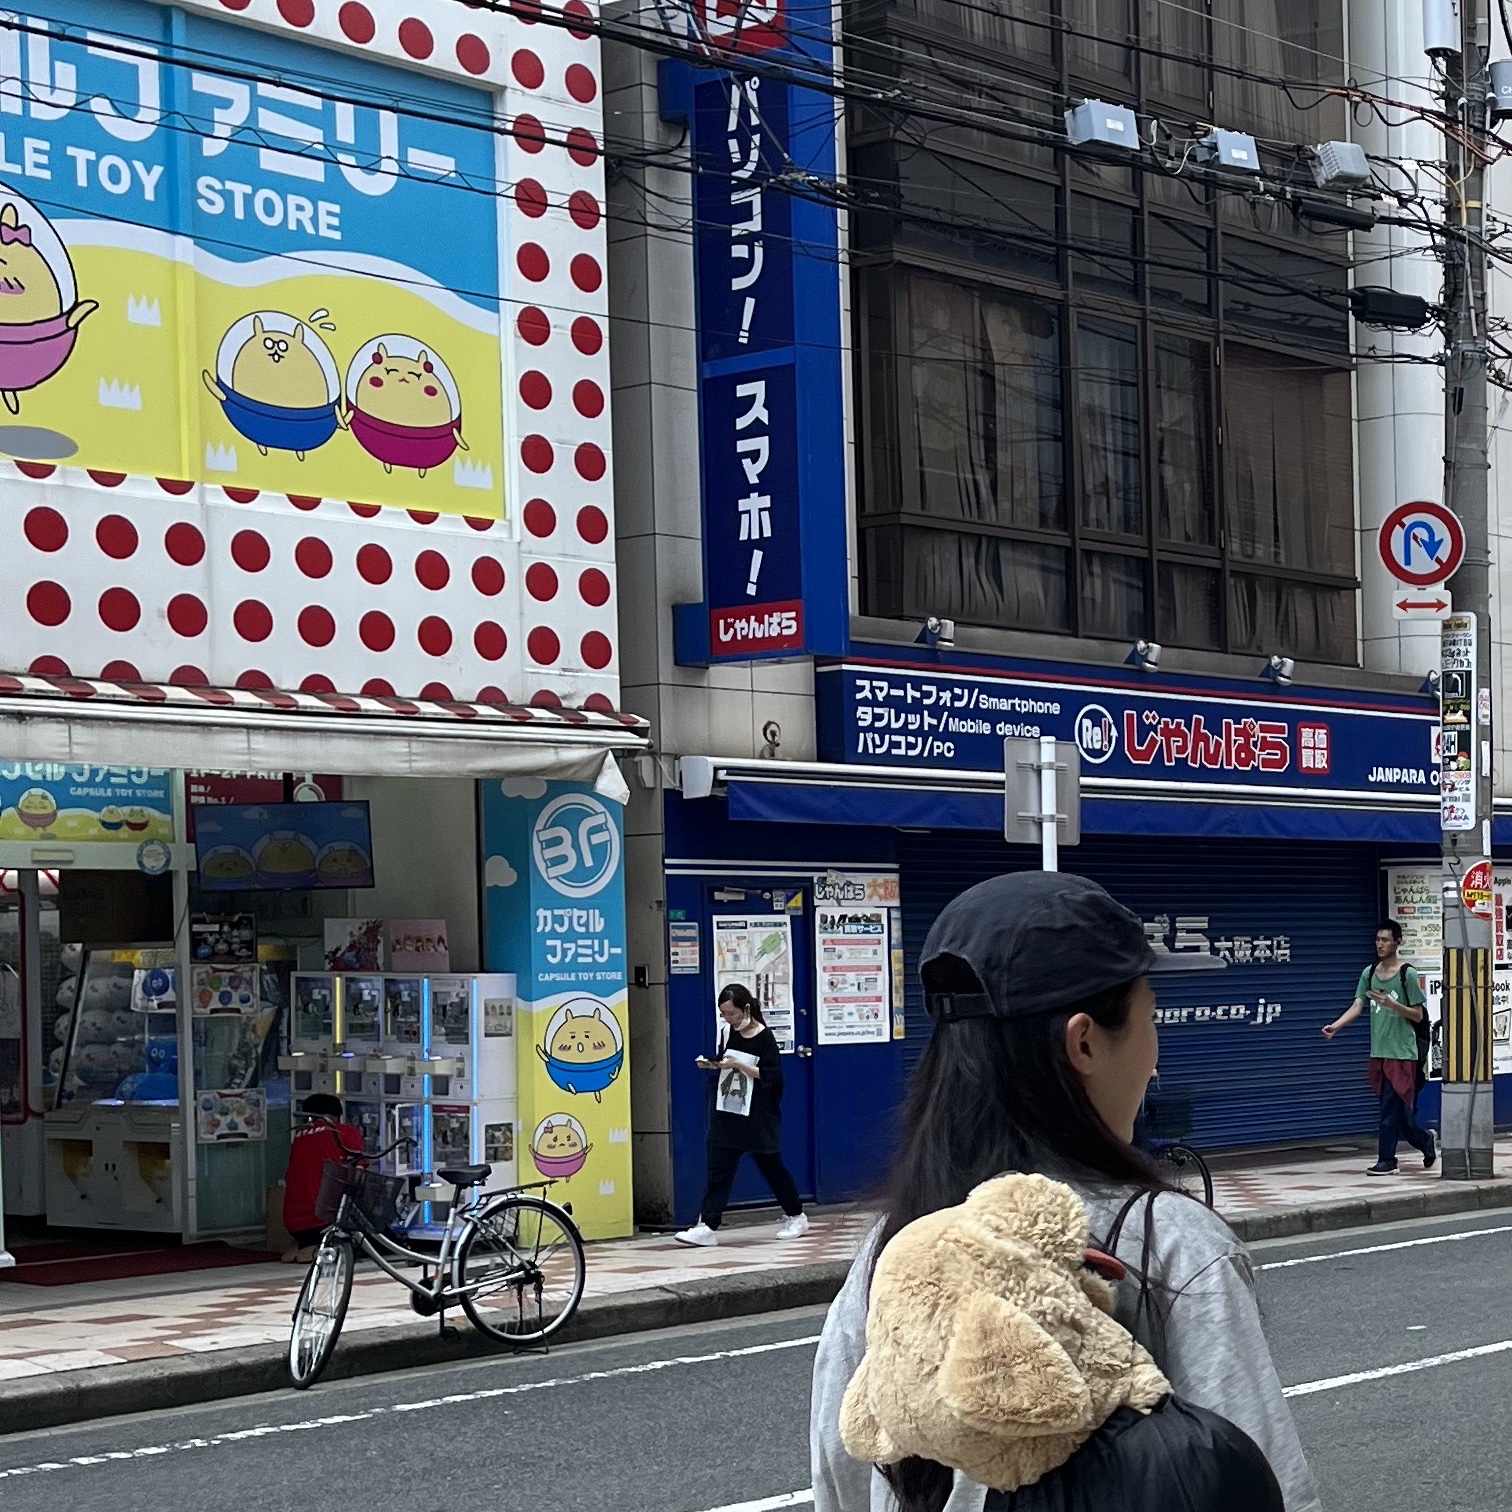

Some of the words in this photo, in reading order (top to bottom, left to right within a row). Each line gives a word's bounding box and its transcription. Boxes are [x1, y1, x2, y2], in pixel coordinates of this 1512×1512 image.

[67, 146, 164, 201] TOY
[197, 175, 342, 241] STORE
[718, 611, 797, 642] じゃんぱら
[996, 721, 1041, 737] device
[1082, 717, 1109, 752] Re!
[1124, 709, 1289, 773] じゃんぱら
[1301, 727, 1327, 749] 高価
[1301, 749, 1328, 770] 買取
[1368, 766, 1426, 784] JANPARA
[536, 908, 606, 934] カプセル
[546, 939, 622, 964] ファミリー
[1214, 935, 1291, 963] 大阪本店
[538, 972, 577, 982] CAPSULE
[578, 972, 594, 981] TOY
[596, 971, 622, 981] STORE
